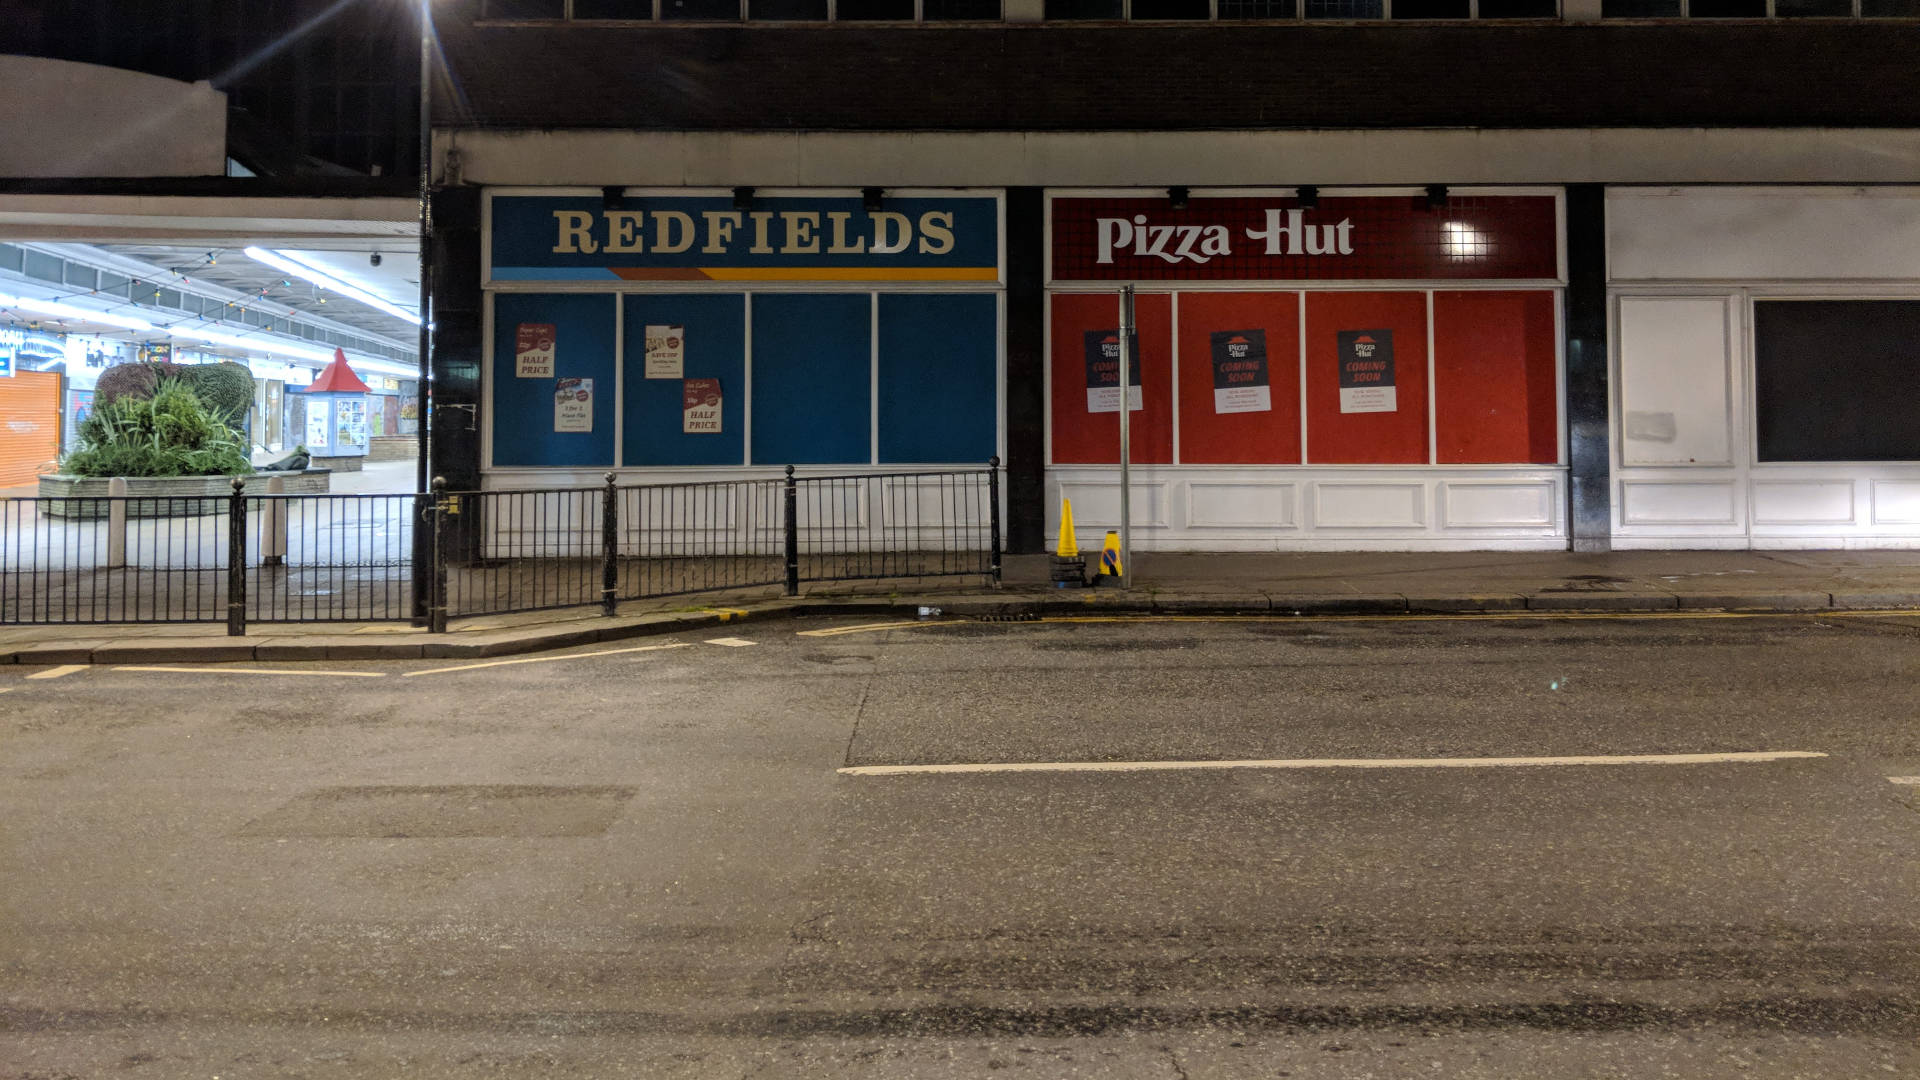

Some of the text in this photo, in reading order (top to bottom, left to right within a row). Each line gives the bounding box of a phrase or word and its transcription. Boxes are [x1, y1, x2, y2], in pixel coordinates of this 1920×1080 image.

[553, 210, 955, 255] REDFIELDS
[1096, 209, 1355, 264] Pizza Hut
[1228, 344, 1248, 352] Pizza
[1355, 344, 1376, 352] Pizza
[523, 356, 549, 364] HALF
[521, 366, 549, 374] PRICE
[1220, 360, 1260, 373] COMING
[1346, 361, 1387, 373] COMING
[1100, 372, 1120, 382] SOO
[1228, 372, 1256, 383] SOON
[1352, 372, 1381, 383] SOON
[689, 421, 717, 429] PRICE
